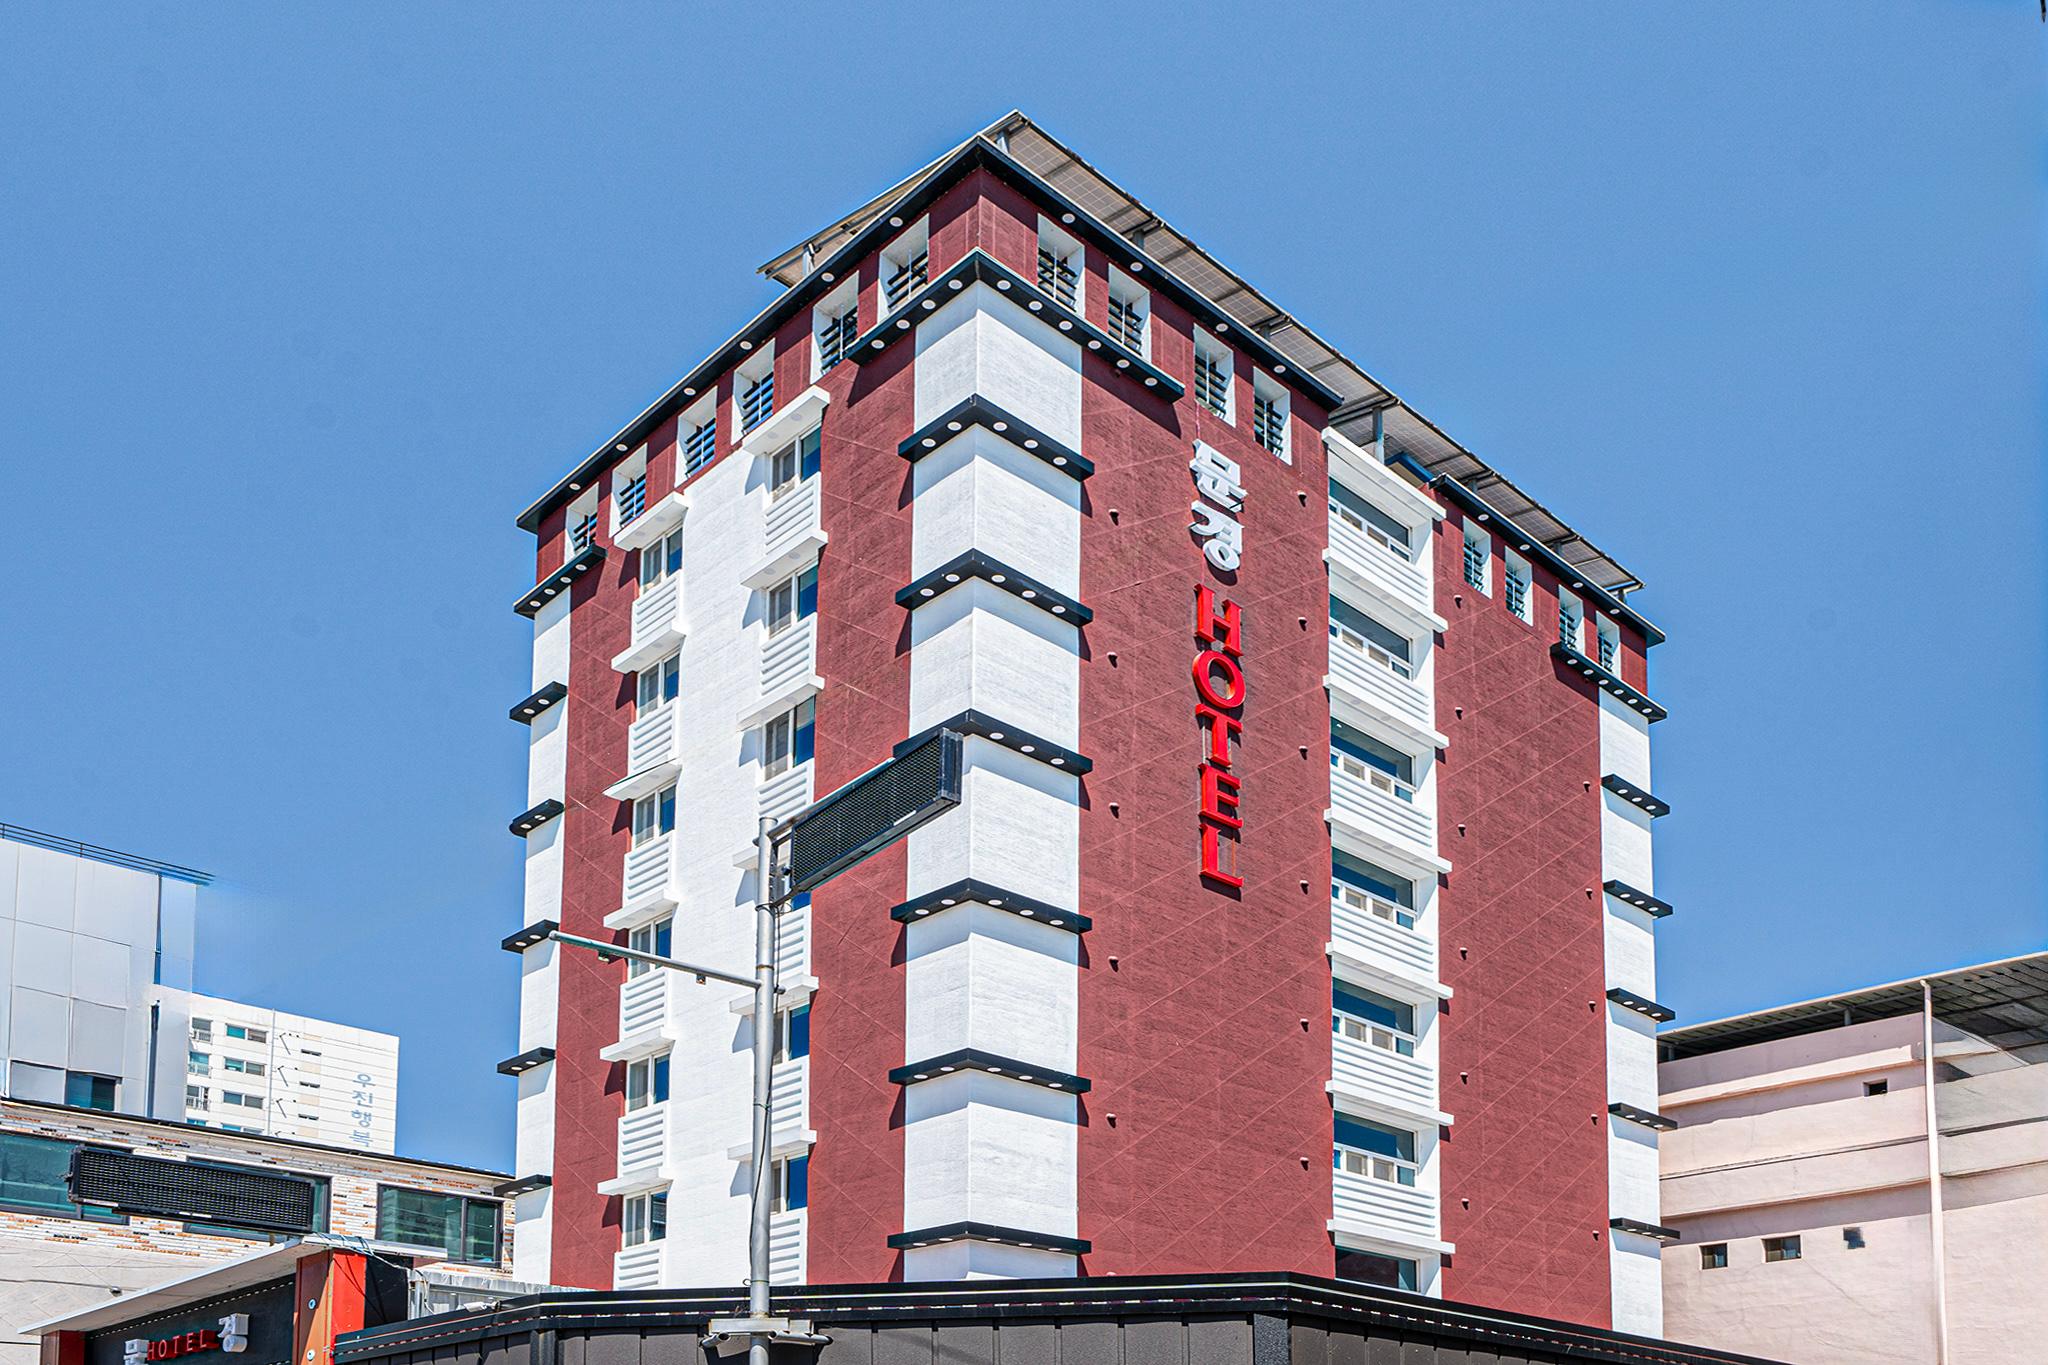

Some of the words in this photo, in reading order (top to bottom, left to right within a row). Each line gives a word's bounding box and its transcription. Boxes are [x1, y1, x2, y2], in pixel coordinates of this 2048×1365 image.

[1192, 584, 1246, 888] HOTEL
[351, 1073, 376, 1147] 우진행복
[147, 1329, 219, 1360] HOTEL
